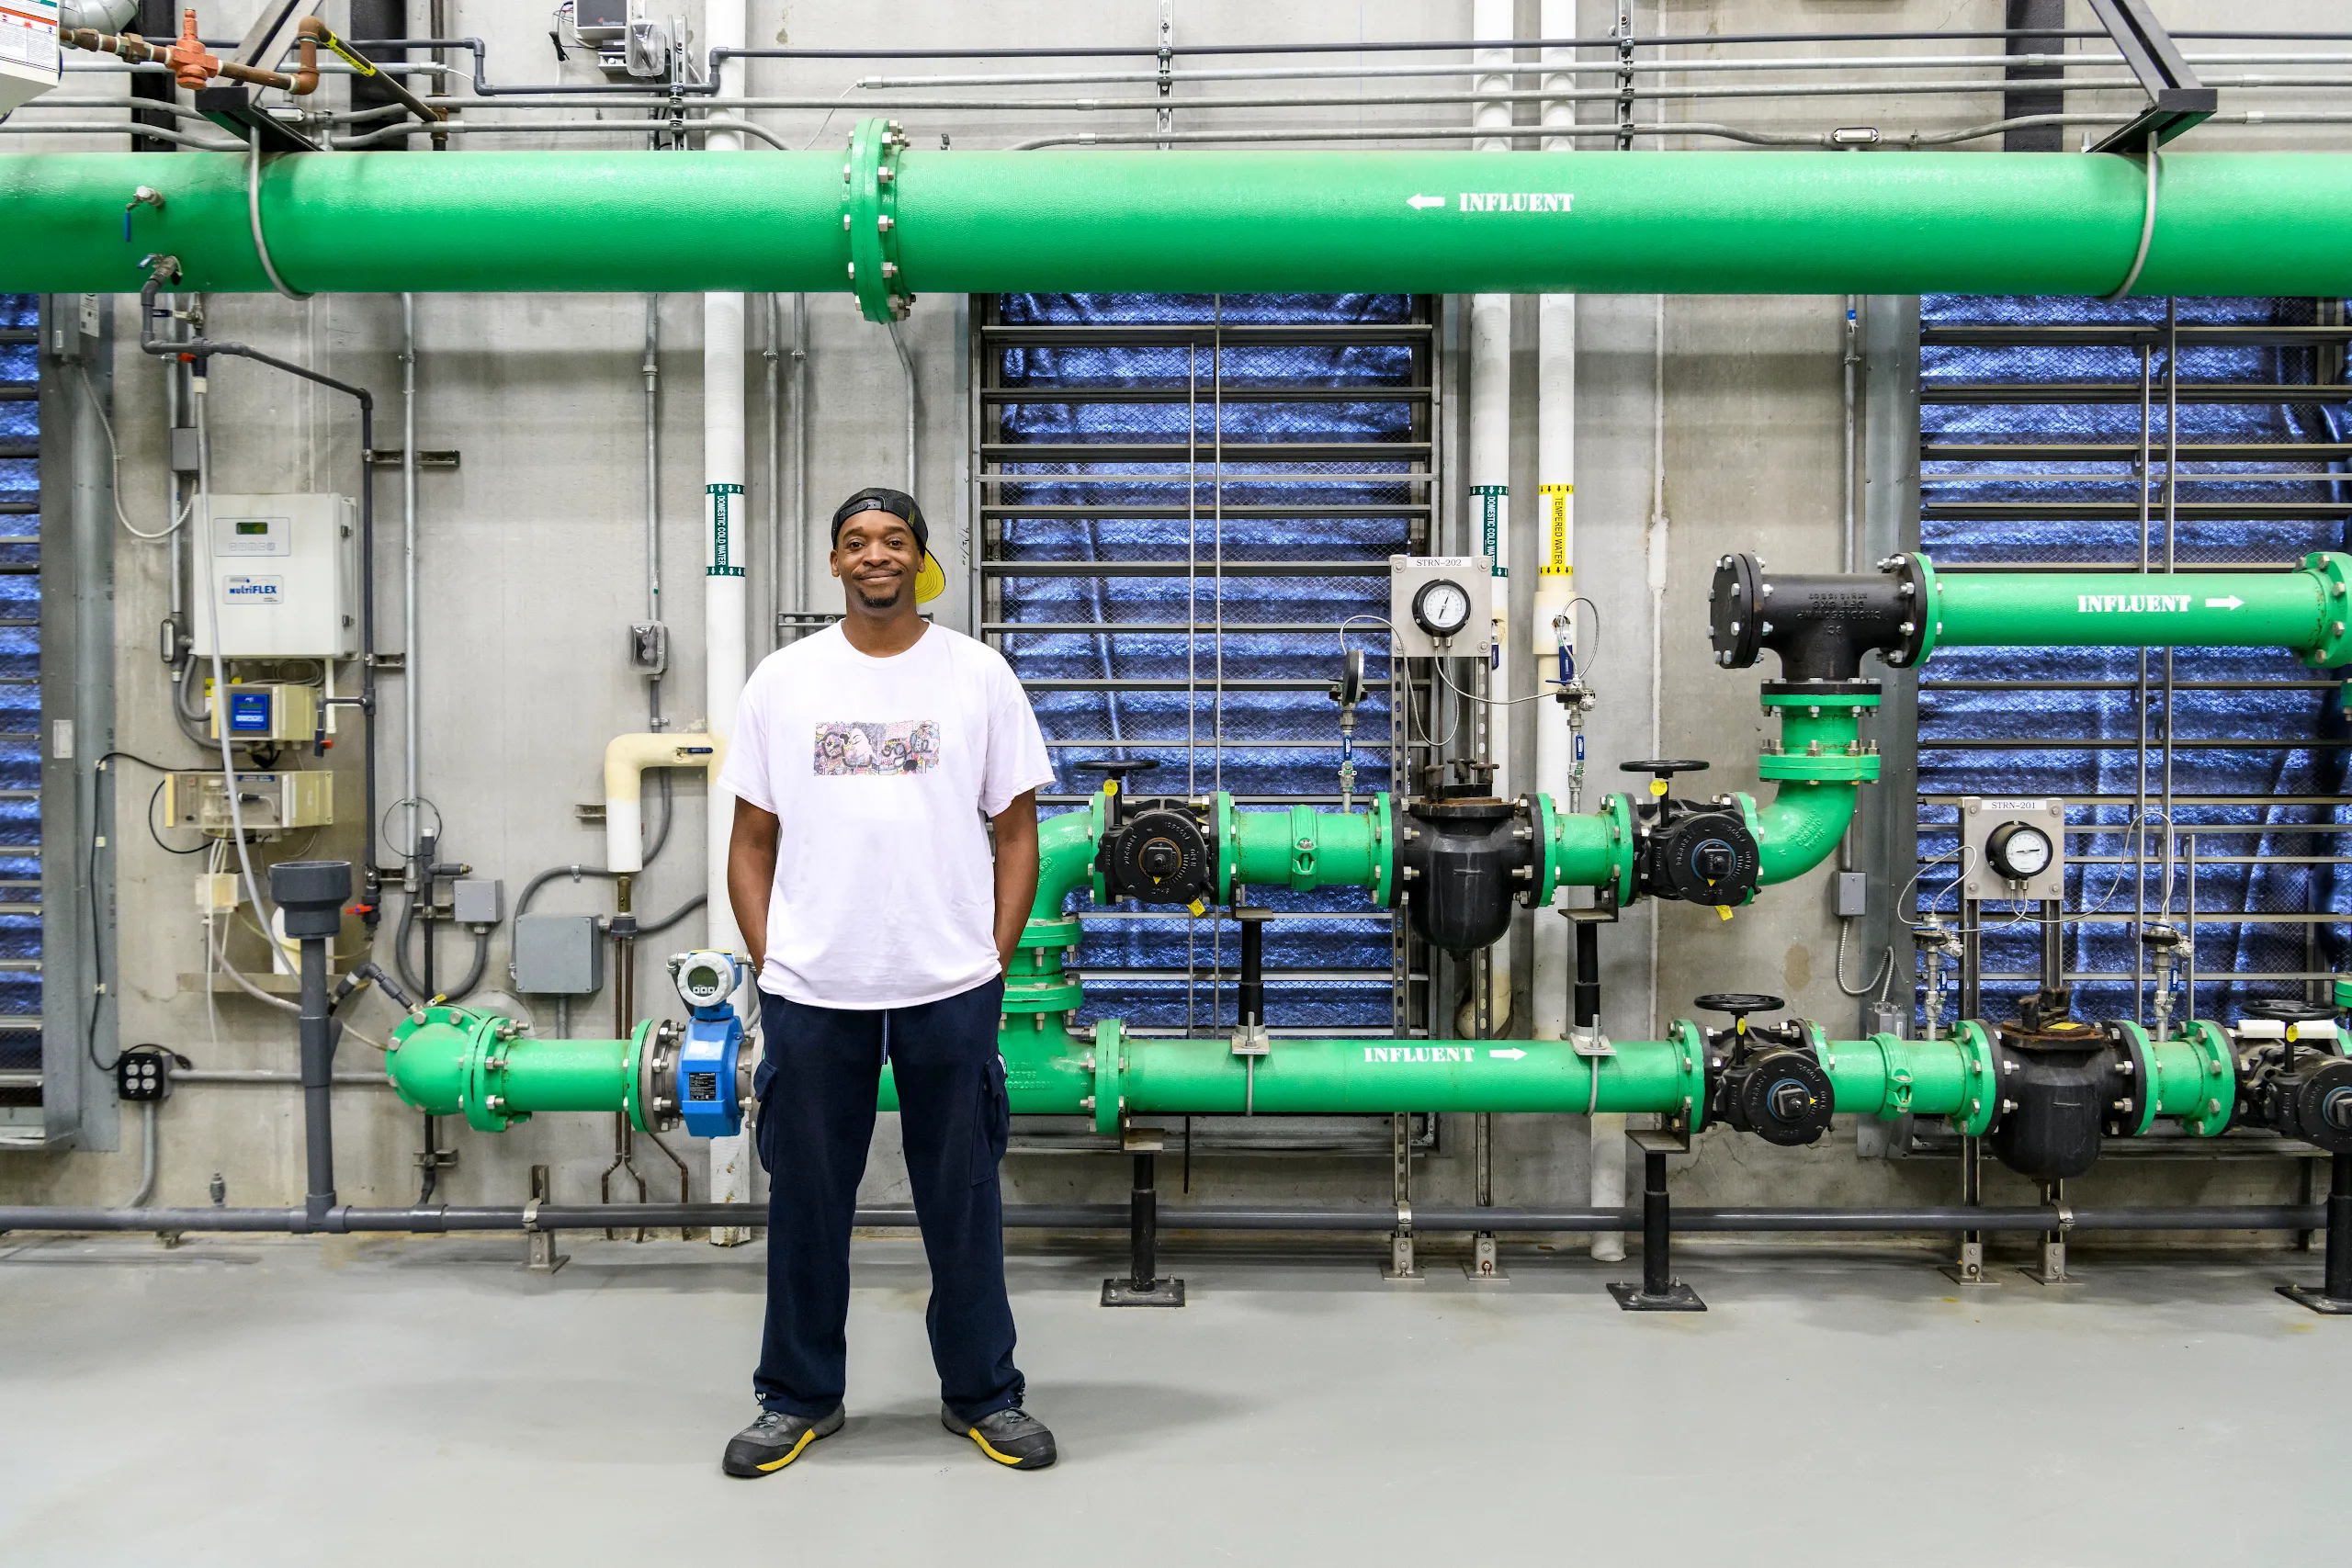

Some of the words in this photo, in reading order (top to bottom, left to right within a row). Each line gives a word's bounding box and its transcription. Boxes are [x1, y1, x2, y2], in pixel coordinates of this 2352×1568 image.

[1459, 192, 1574, 212] INFLUENT
[717, 495, 726, 526] DOMESTIC
[1487, 496, 1496, 527] DOMESTIC
[1555, 497, 1564, 537] TEMPERED
[717, 526, 726, 544] COLD
[1487, 528, 1496, 545] COLD
[718, 545, 727, 566] WATER
[1554, 538, 1563, 565] WATER
[1416, 558, 1463, 567] STRN-202
[2077, 594, 2192, 613] INFLUENT
[1363, 1047, 1475, 1063] INFLUENT
